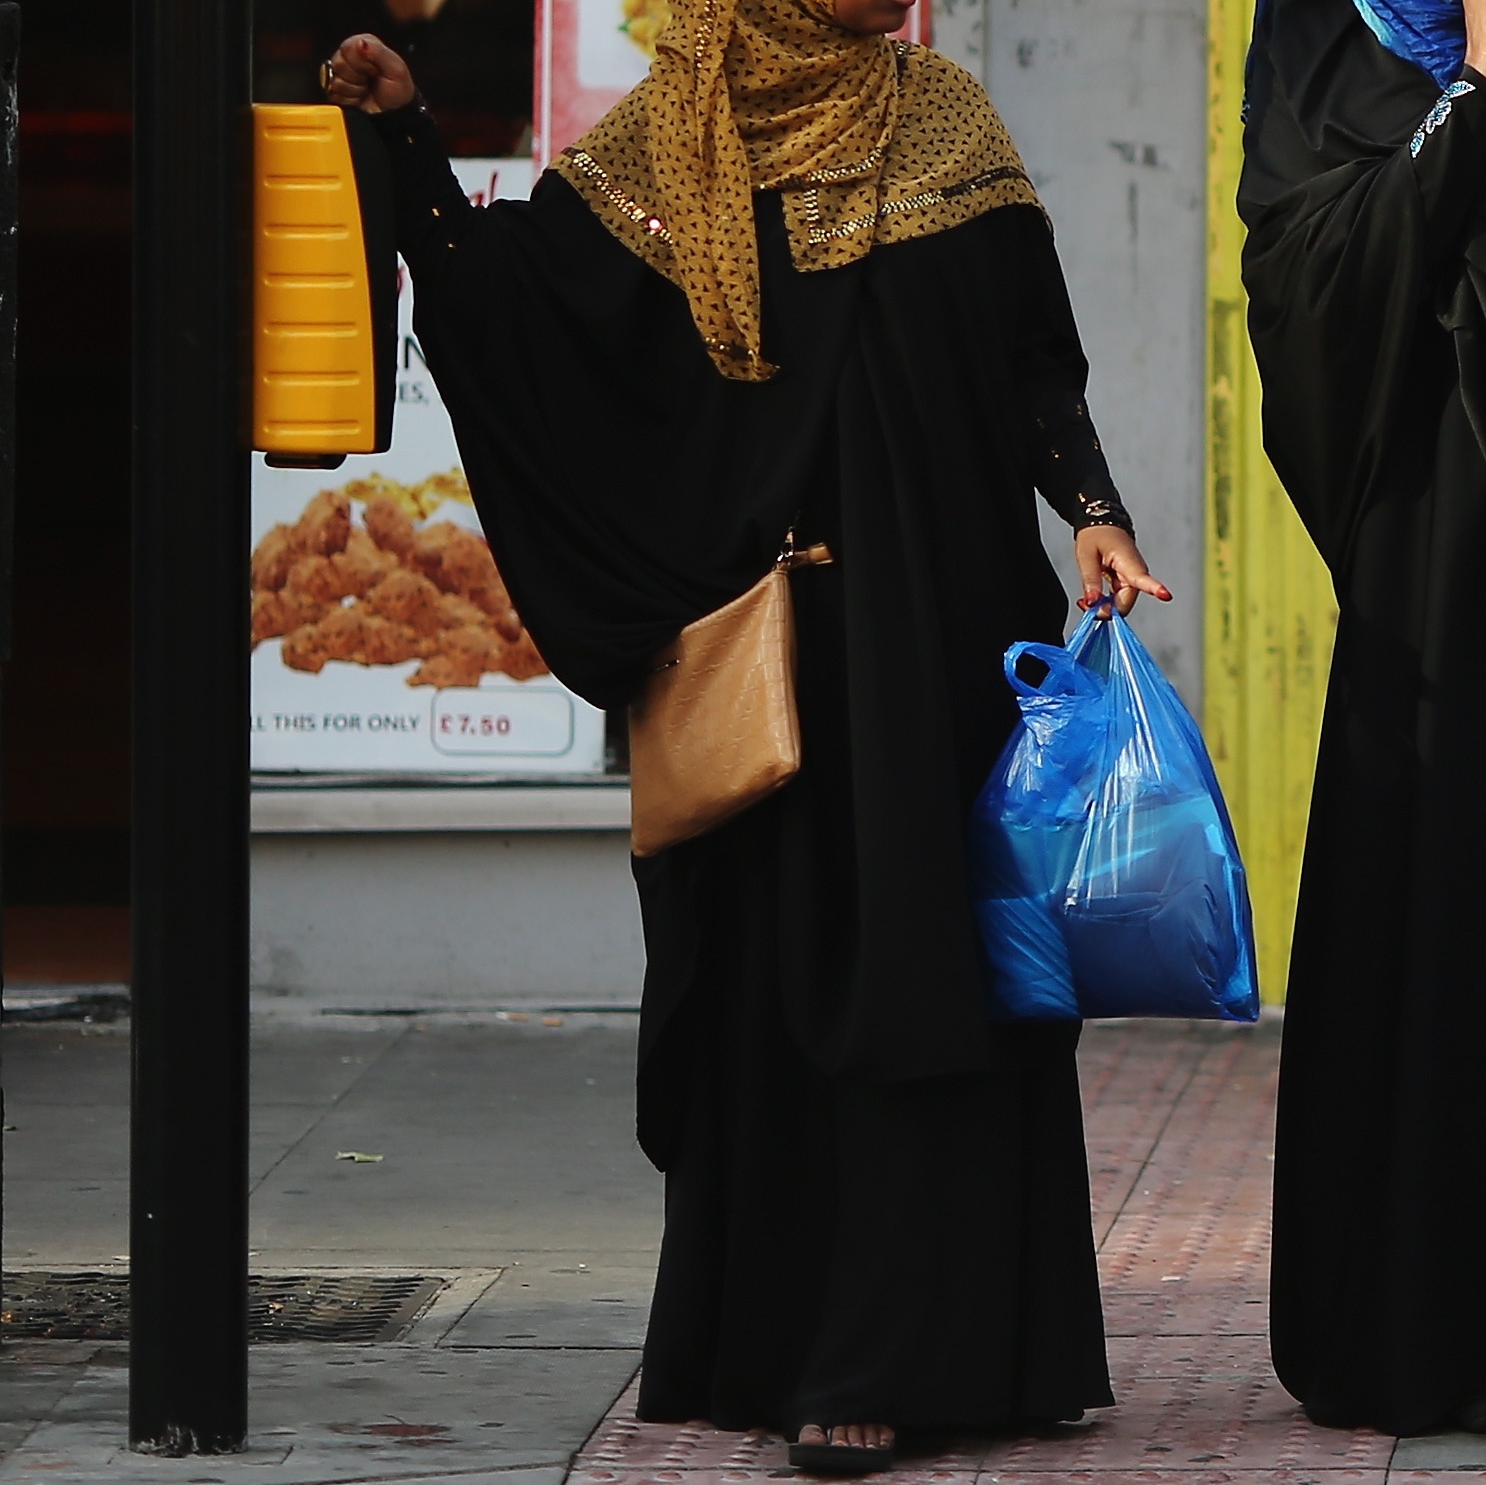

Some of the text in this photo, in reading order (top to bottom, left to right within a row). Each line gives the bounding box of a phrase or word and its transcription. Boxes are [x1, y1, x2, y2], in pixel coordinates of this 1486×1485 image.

[399, 381, 430, 406] ES,
[274, 713, 317, 732] THIS
[322, 713, 362, 733] FOR
[367, 713, 420, 732] ONLY
